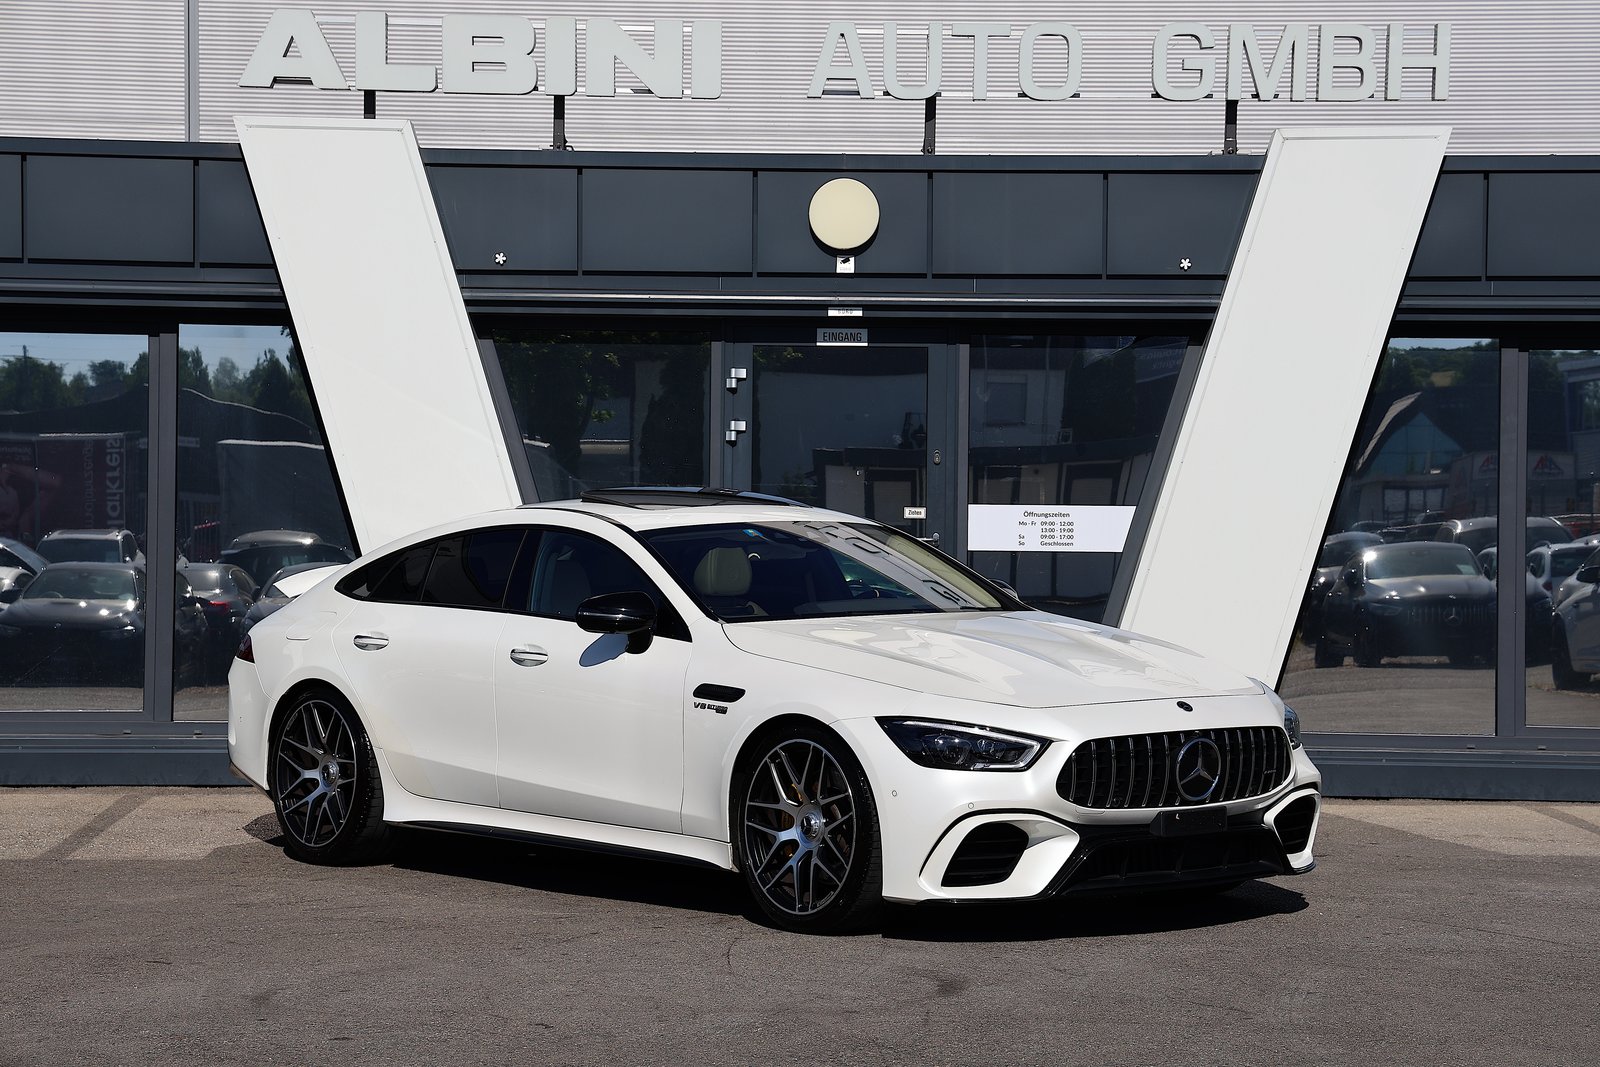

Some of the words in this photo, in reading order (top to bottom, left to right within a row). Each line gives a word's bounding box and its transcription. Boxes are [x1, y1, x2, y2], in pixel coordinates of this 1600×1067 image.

[238, 9, 723, 99] ALBINI
[806, 21, 1083, 101] AUTO
[1152, 22, 1451, 101] GMBH
[823, 332, 862, 342] EINGANG
